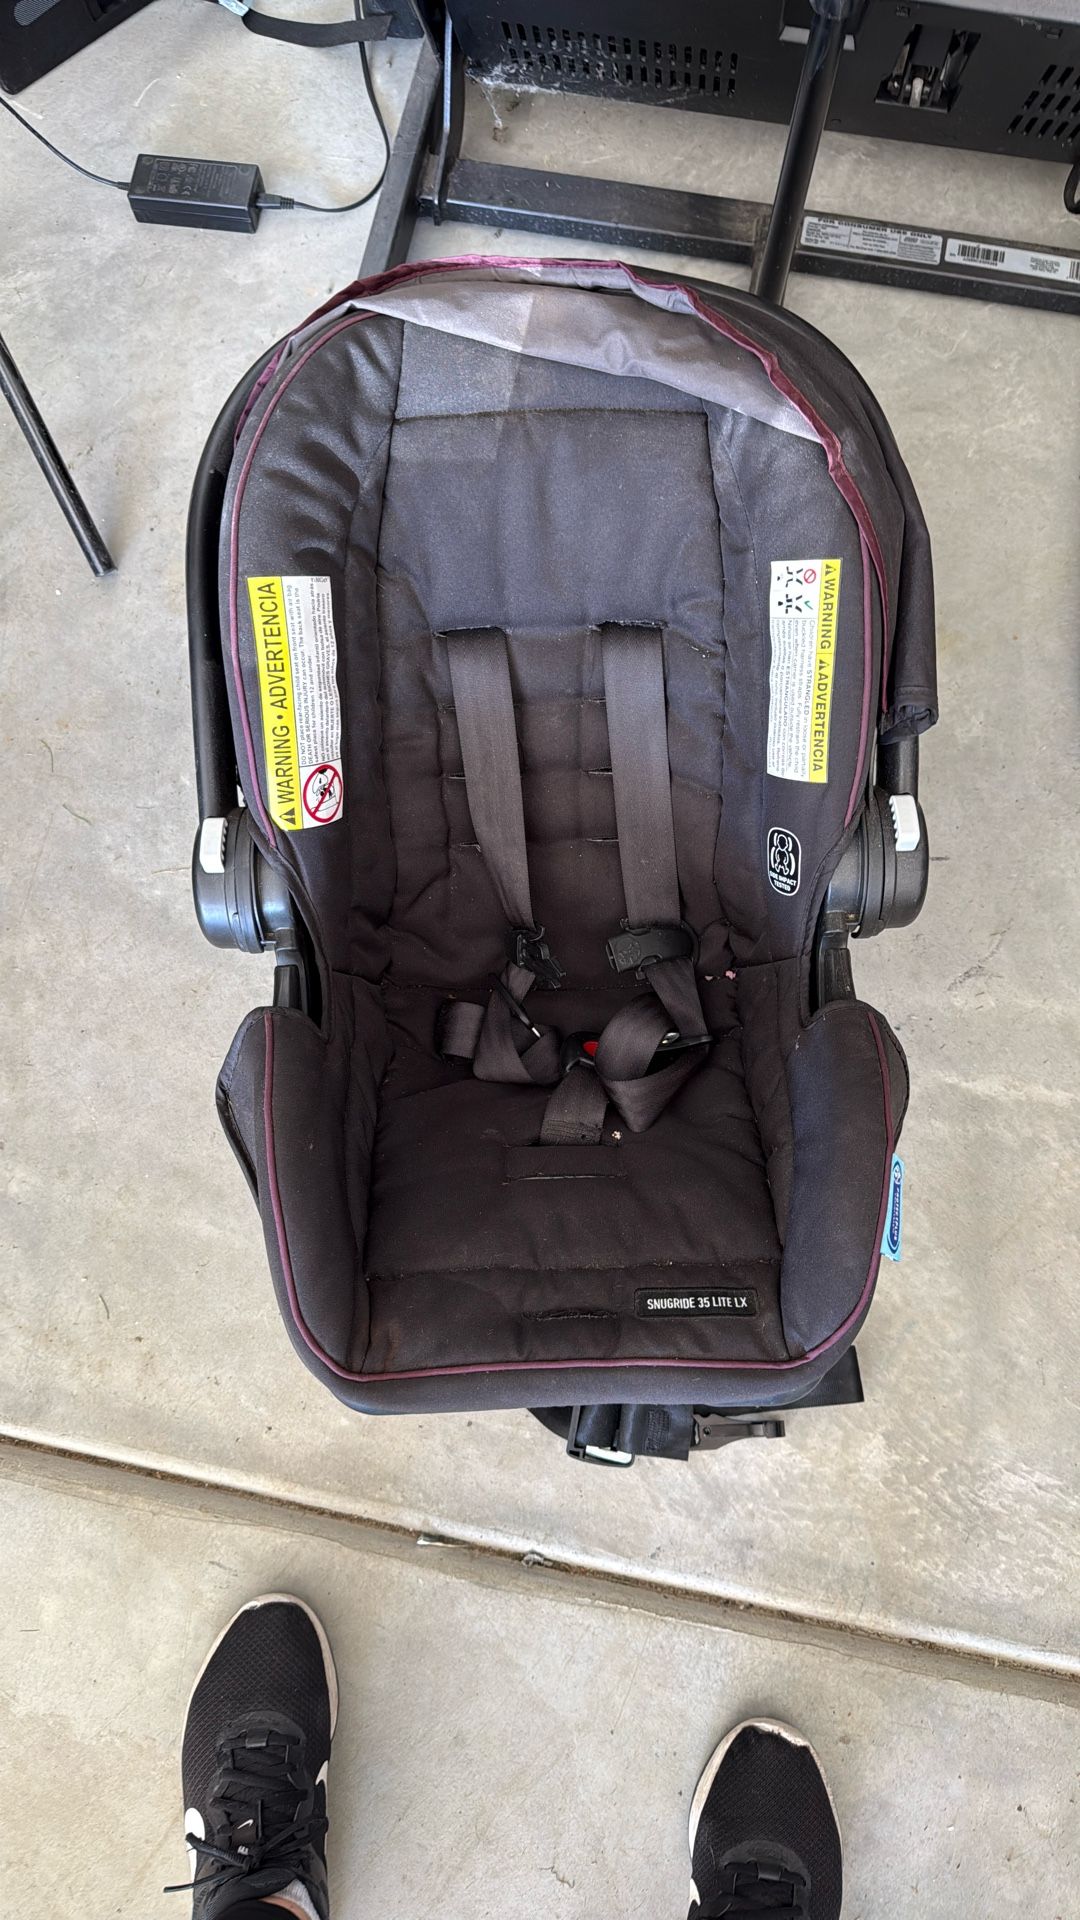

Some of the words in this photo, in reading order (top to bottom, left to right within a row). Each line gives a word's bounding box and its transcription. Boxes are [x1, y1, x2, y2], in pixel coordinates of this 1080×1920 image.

[820, 578, 835, 649] WARNING
[256, 581, 288, 710] ADVERTENCIA
[293, 652, 298, 660] on
[803, 669, 812, 716] STRANGLED
[303, 704, 311, 732] SERIOUS
[812, 672, 829, 772] ADVERTENCIA
[305, 733, 311, 743] OR
[270, 724, 296, 804] WARNING
[300, 755, 306, 765] DO
[773, 879, 791, 892] TESTED
[778, 875, 797, 886] IMPACT
[647, 1297, 696, 1310] SNUGRIDE
[697, 1297, 710, 1308] 35
[712, 1296, 733, 1308] LITE
[734, 1297, 748, 1308] LX
